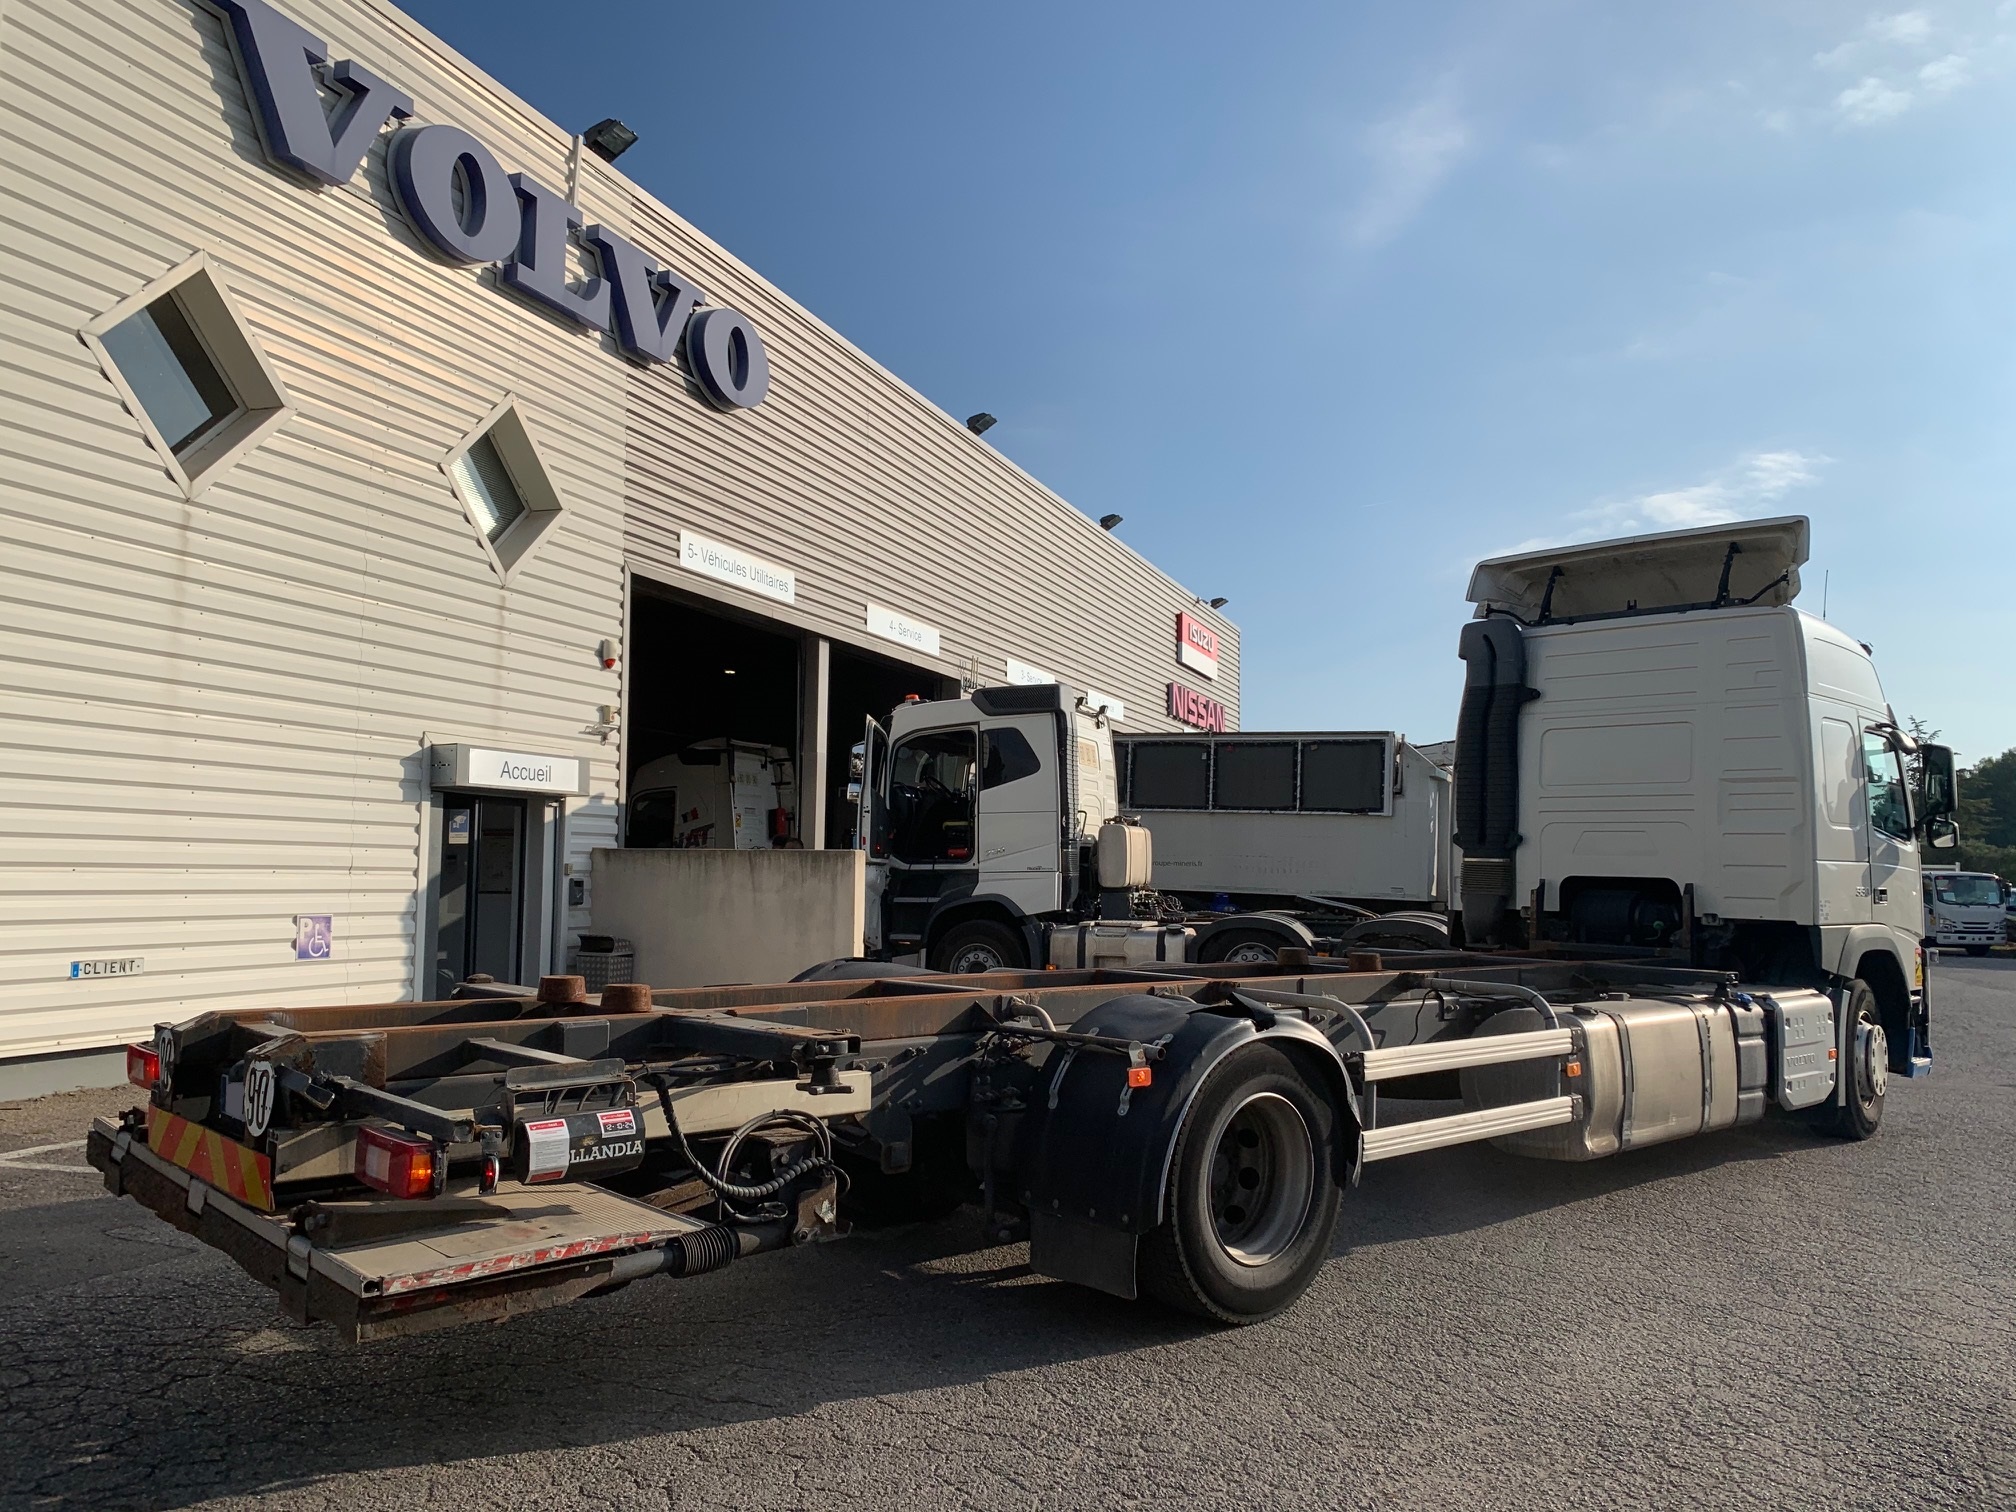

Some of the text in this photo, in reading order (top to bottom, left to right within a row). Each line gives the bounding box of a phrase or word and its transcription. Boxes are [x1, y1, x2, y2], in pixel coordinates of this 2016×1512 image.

[215, 0, 770, 411] VOLVO
[687, 542, 789, 593] 5- Véhicules Utilitaires
[889, 619, 922, 643] 4- Service
[1188, 622, 1214, 653] ISUZU
[1169, 682, 1226, 732] NISSAN
[500, 760, 552, 783] Accueil
[83, 960, 136, 975] CLIENT
[246, 1066, 270, 1130] 90
[569, 1139, 643, 1164] LLANDIA
